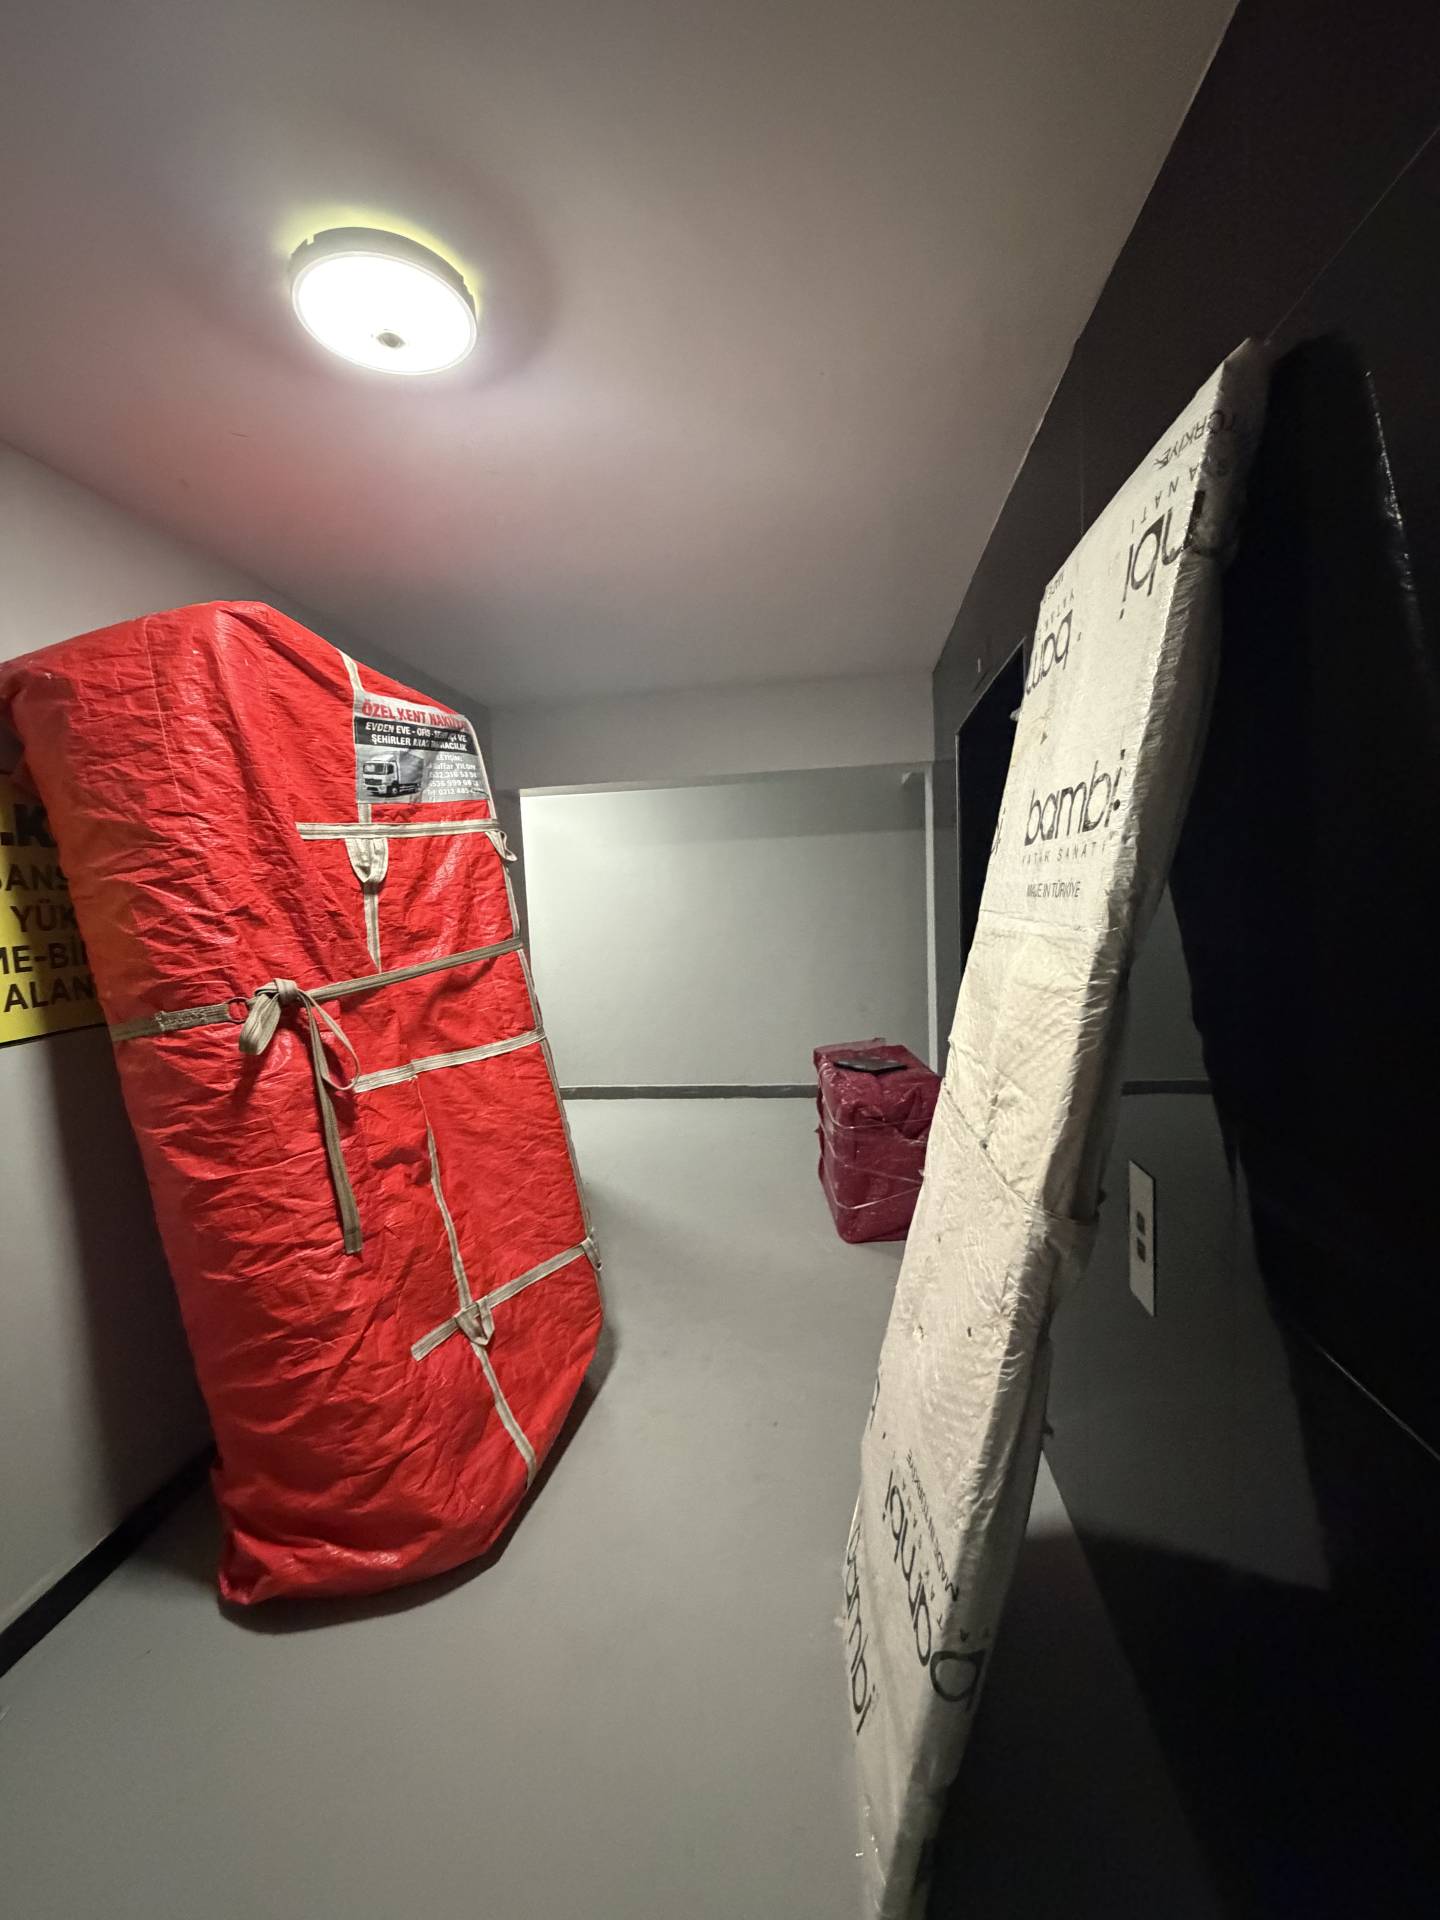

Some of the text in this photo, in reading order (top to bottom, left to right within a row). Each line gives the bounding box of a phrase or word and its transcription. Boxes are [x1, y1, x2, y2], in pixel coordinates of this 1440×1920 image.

[361, 699, 397, 720] ÖZEL
[397, 707, 426, 724] KENT
[365, 721, 395, 734] EVDEN
[396, 725, 411, 736] EVE
[371, 732, 411, 746] ŞEHİRLER
[1024, 749, 1126, 847] bambi
